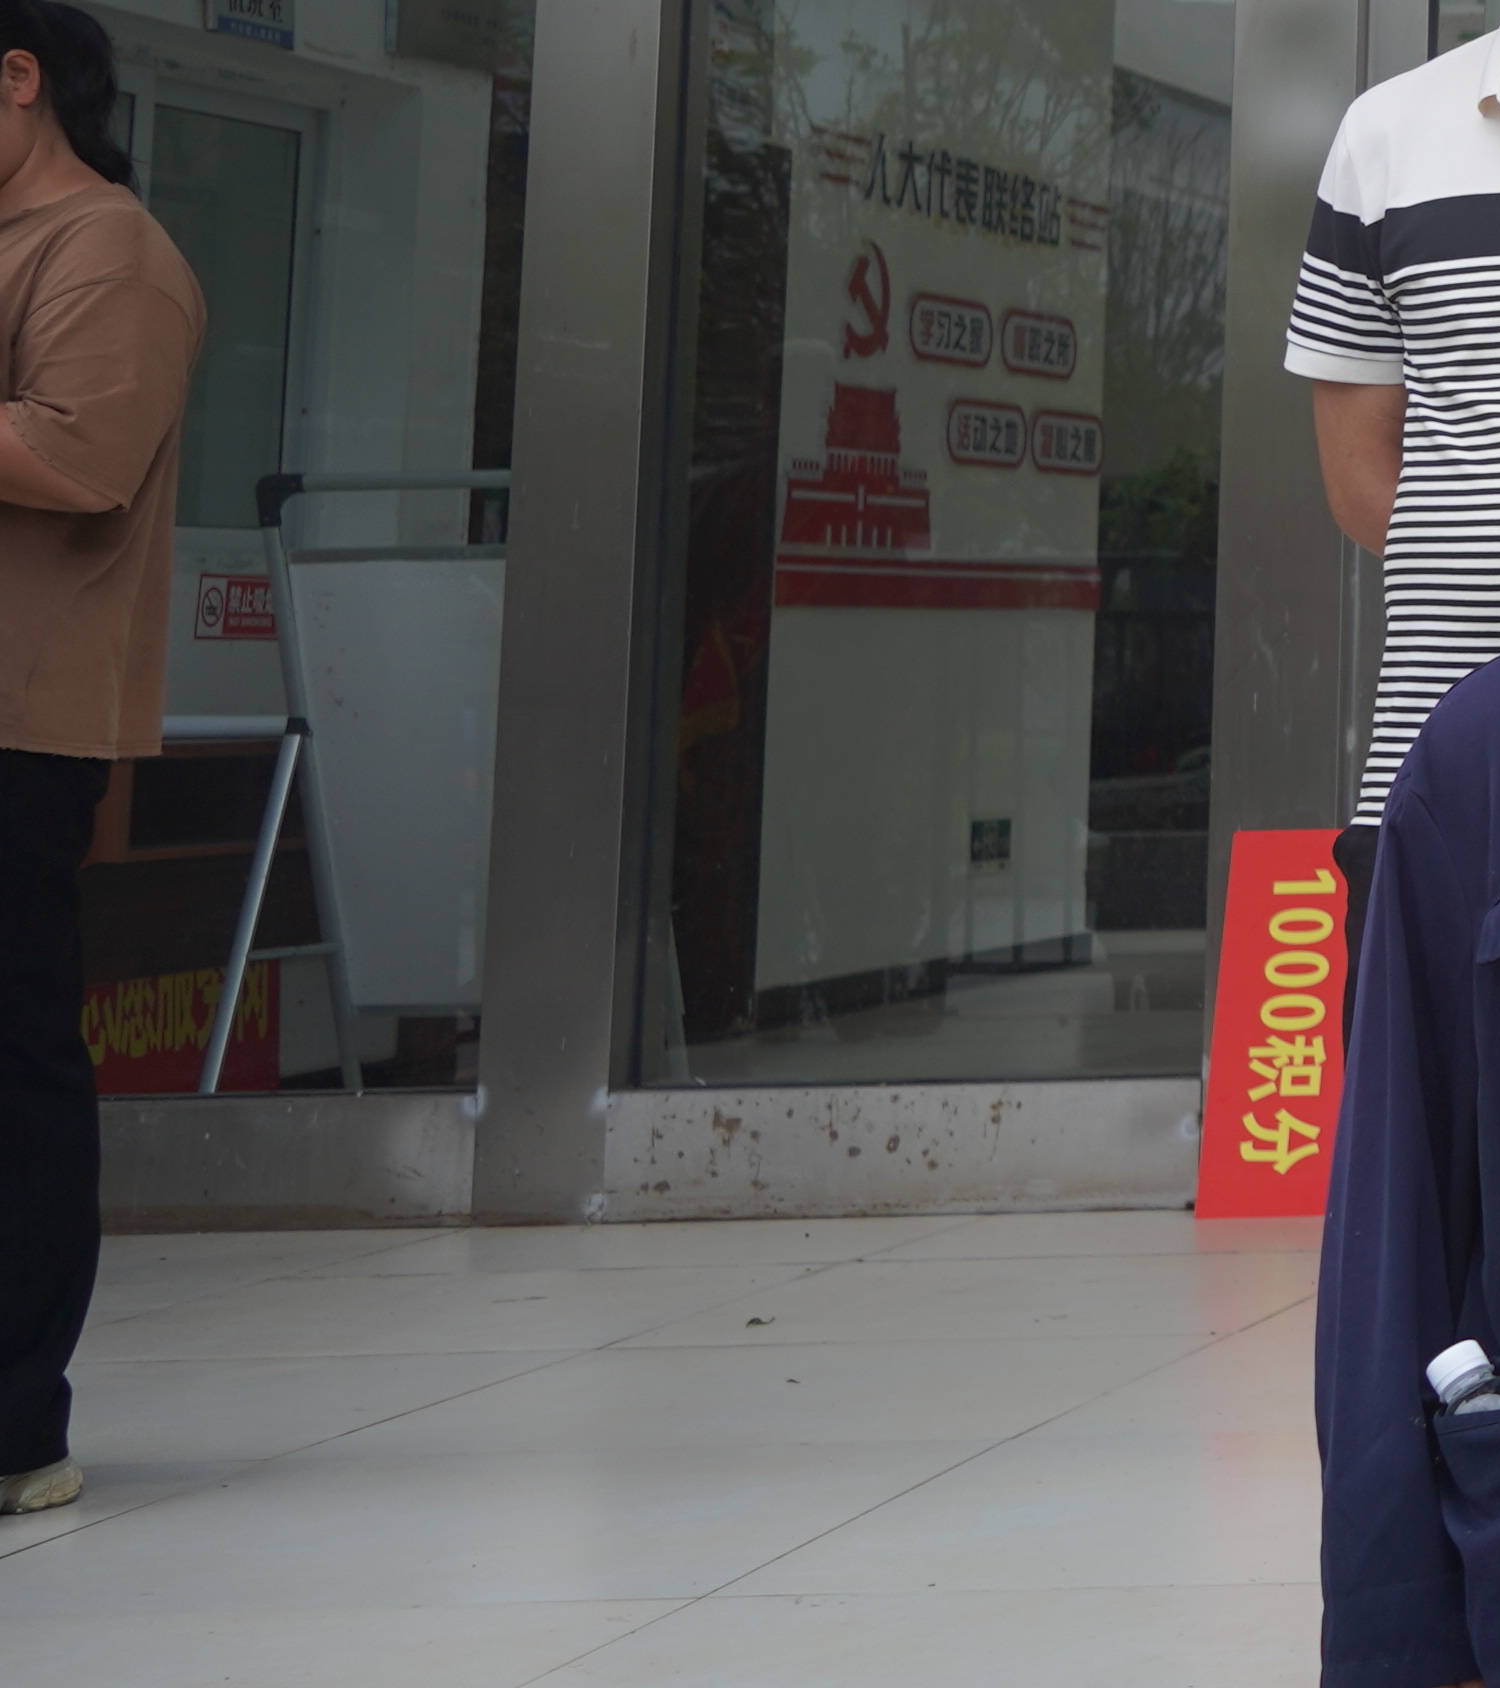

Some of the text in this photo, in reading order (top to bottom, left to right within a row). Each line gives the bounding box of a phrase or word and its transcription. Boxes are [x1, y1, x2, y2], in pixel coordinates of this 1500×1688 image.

[865, 133, 1062, 247] 人大代表联络站
[1240, 867, 1337, 1175] 1000积分
